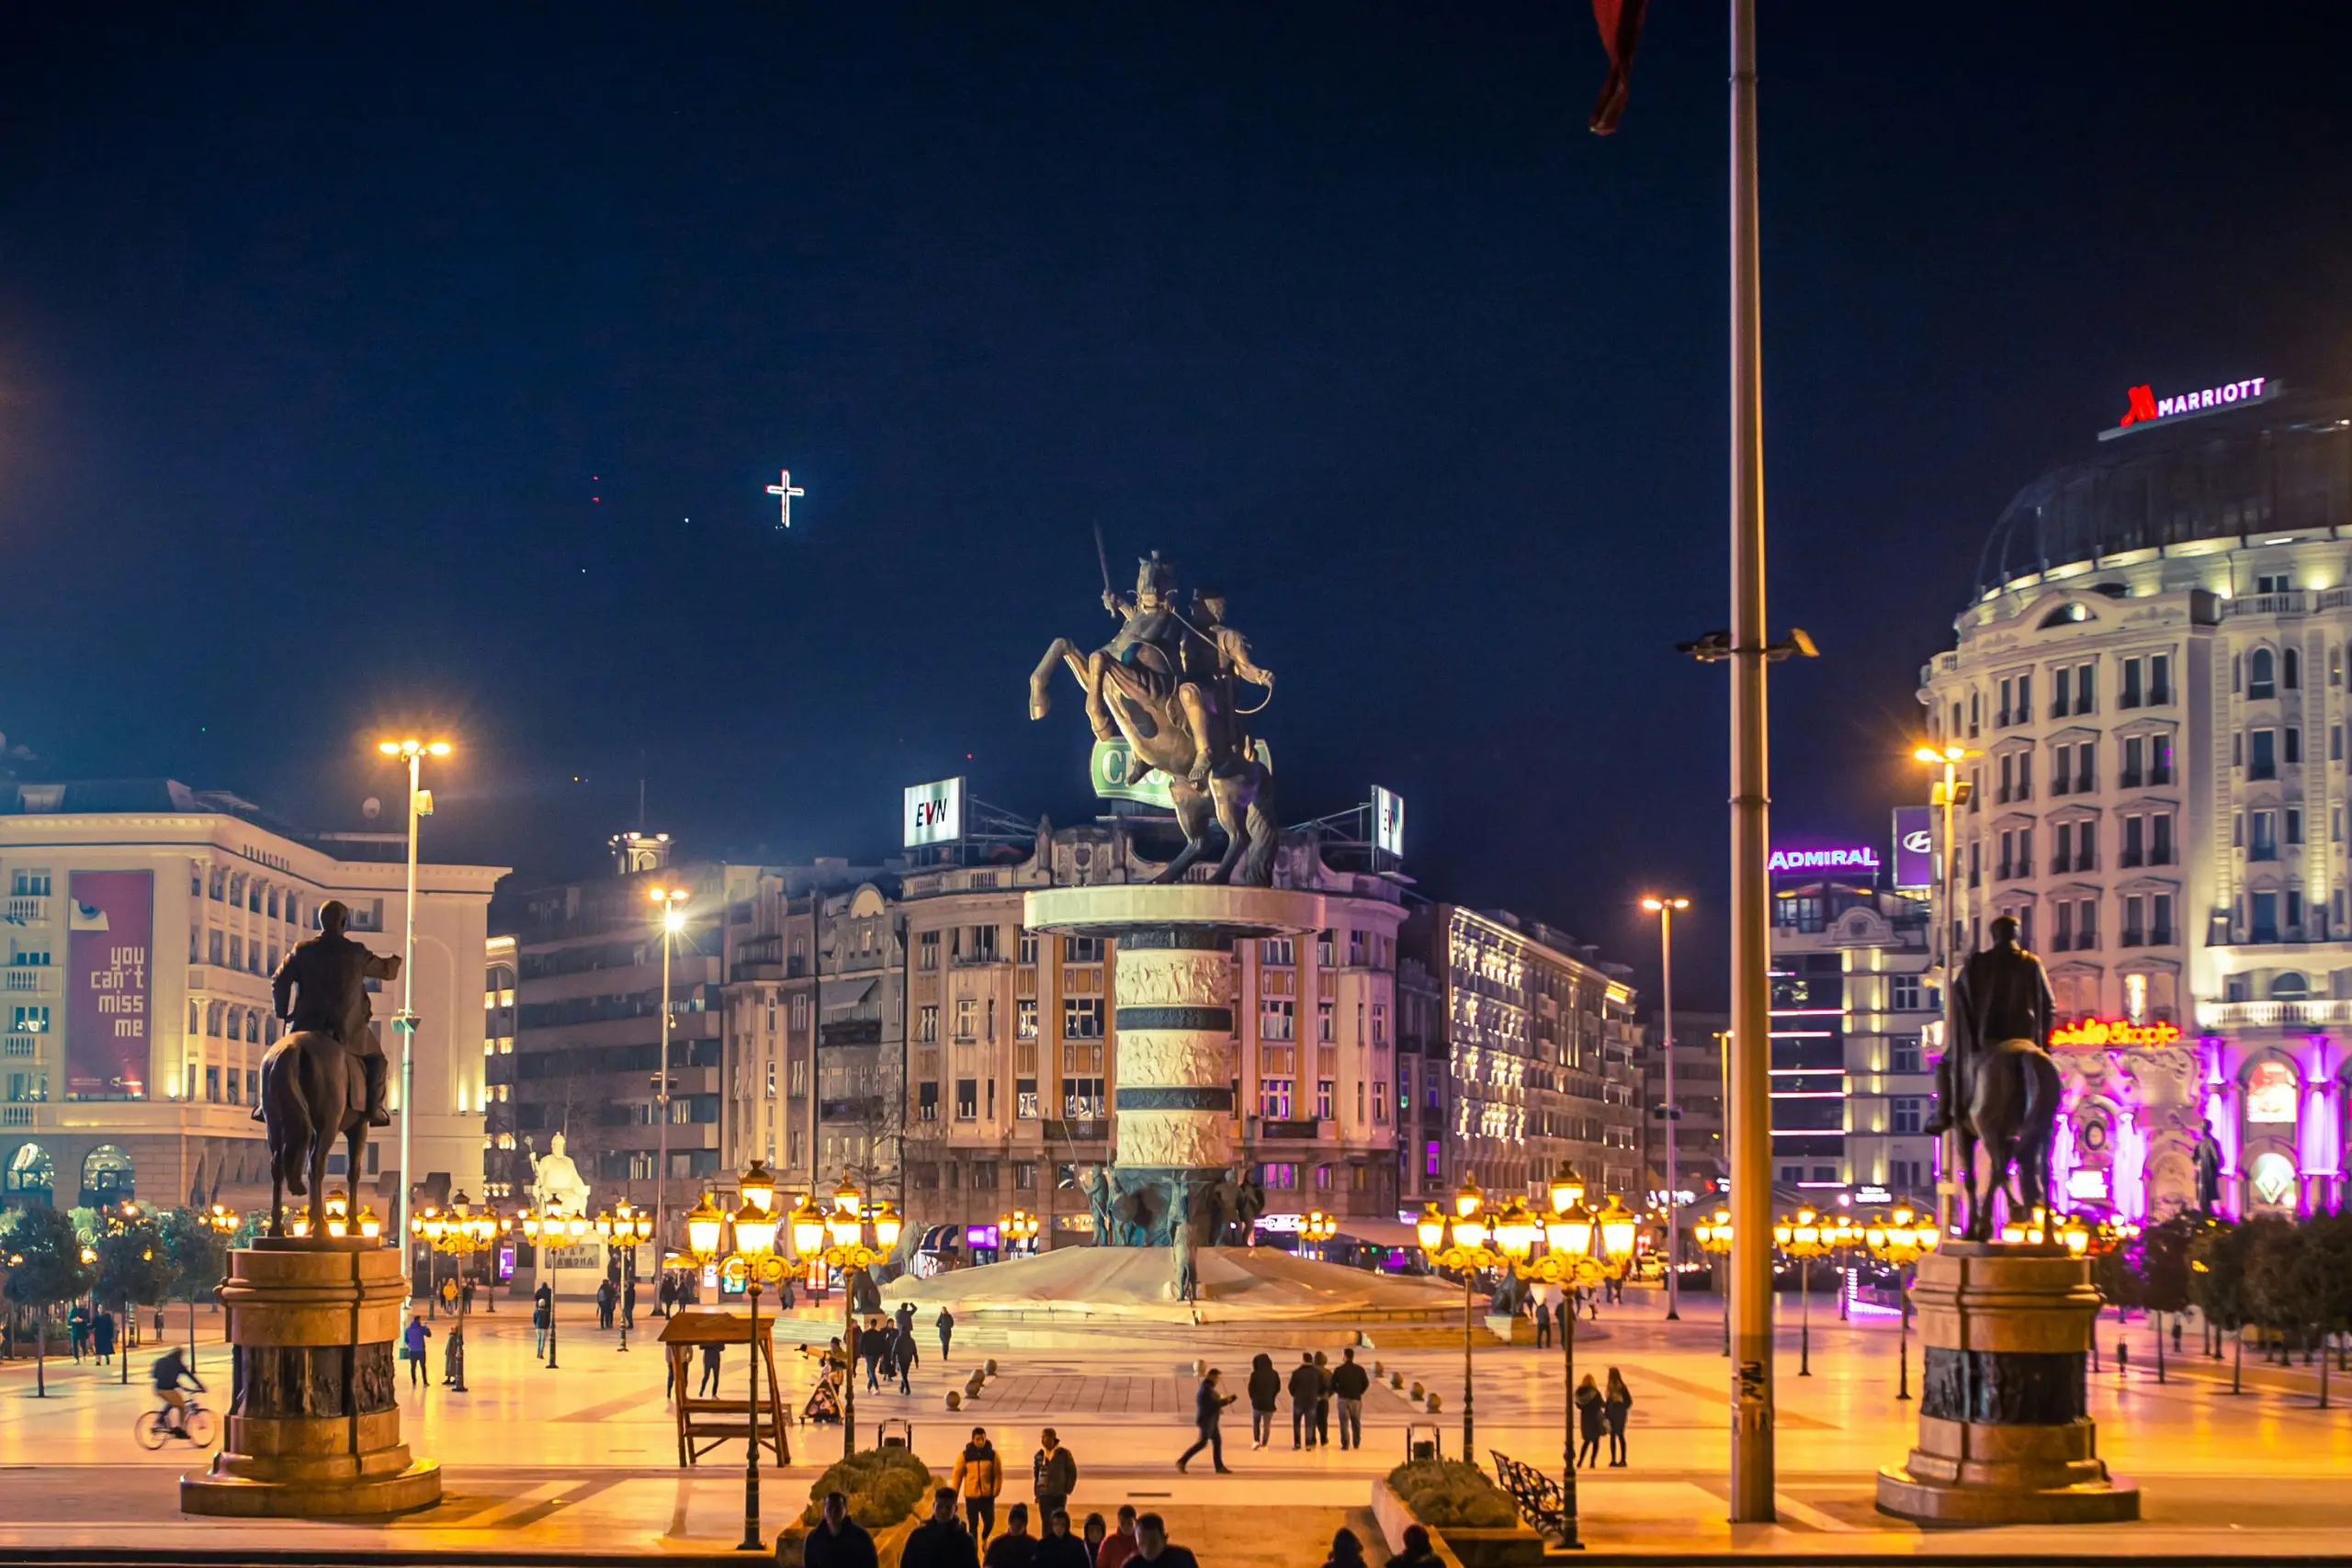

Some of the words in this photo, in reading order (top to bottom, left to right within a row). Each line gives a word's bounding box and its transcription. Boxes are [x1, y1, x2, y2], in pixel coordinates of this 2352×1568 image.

[2159, 378, 2265, 417] MARRIOTT
[916, 798, 947, 828] EVN
[1768, 847, 1880, 870] ADMIRAL
[111, 947, 144, 971] you
[90, 965, 144, 988] can't
[98, 990, 143, 1012] miss
[115, 1020, 143, 1036] me
